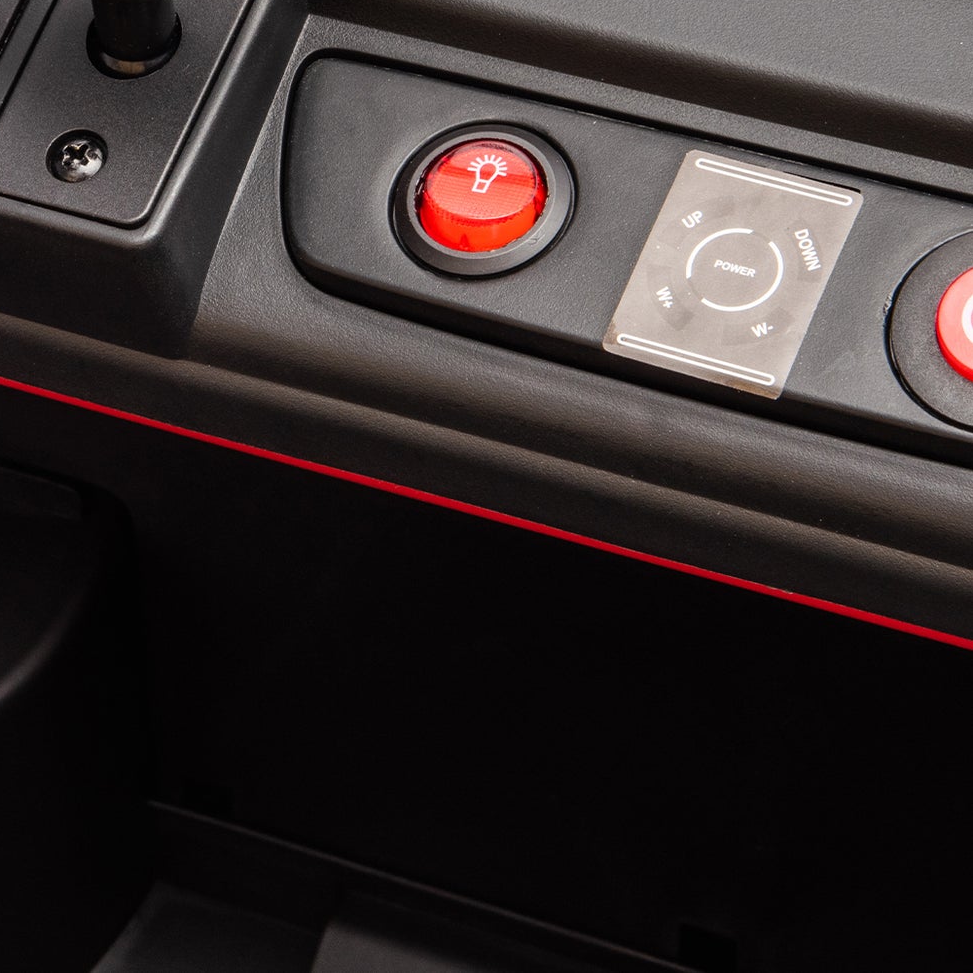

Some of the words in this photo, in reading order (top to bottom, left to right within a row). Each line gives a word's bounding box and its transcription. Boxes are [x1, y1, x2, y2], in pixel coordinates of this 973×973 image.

[681, 210, 704, 229] UP
[794, 228, 822, 272] DOWN
[713, 258, 756, 278] POWER
[655, 285, 674, 310] W+
[750, 321, 774, 339] W-
